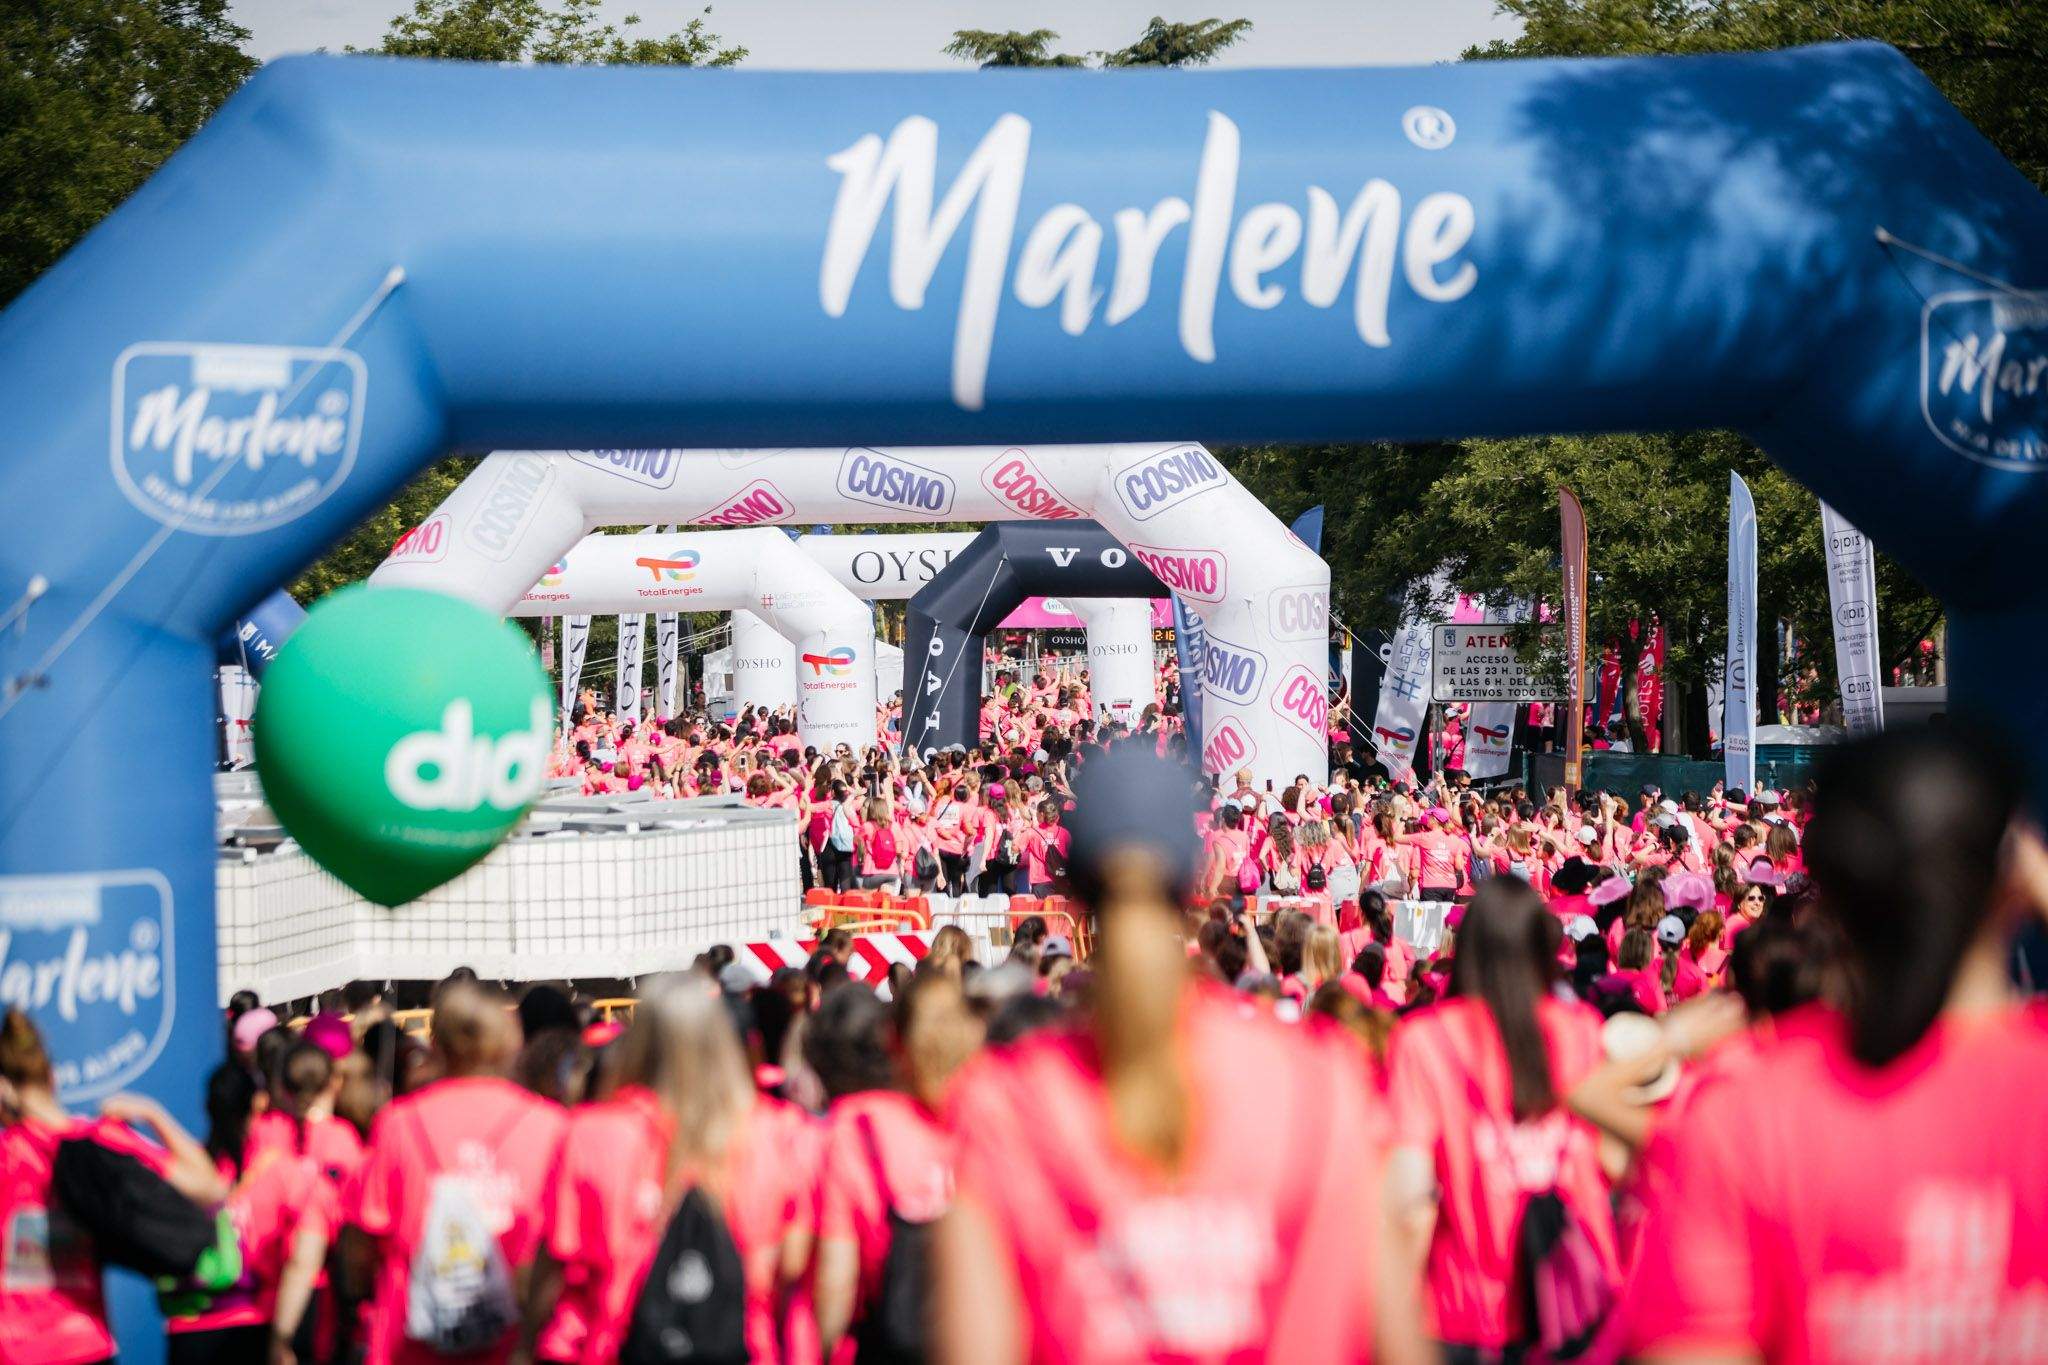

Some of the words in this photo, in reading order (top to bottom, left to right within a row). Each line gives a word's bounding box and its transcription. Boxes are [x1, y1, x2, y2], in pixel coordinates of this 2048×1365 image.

[819, 109, 1479, 412] Marlene
[1939, 332, 2048, 424] Mar
[129, 384, 347, 486] Marlene
[848, 455, 945, 511] COSMO
[1125, 450, 1218, 511] COSMO
[472, 457, 546, 551] COSMO
[520, 592, 571, 602] alEnergies
[637, 586, 703, 598] TotalEnergies
[1278, 591, 1329, 634] COS
[1051, 635, 1086, 646] OYSHO
[1152, 629, 1176, 643] 2:16
[1092, 643, 1139, 657] OYSHO
[736, 657, 782, 670] OYSHO
[1466, 656, 1509, 664] ACCESO
[1204, 640, 1256, 696] OSMO
[1443, 667, 1456, 675] DE
[1460, 667, 1480, 675] LAS
[1485, 667, 1497, 675] 23
[803, 681, 858, 690] TotalEnergies
[1453, 688, 1503, 697] FESTIVOS
[1508, 688, 1536, 697] TODO
[1540, 689, 1553, 697] EL
[0, 922, 162, 1023] arlene
